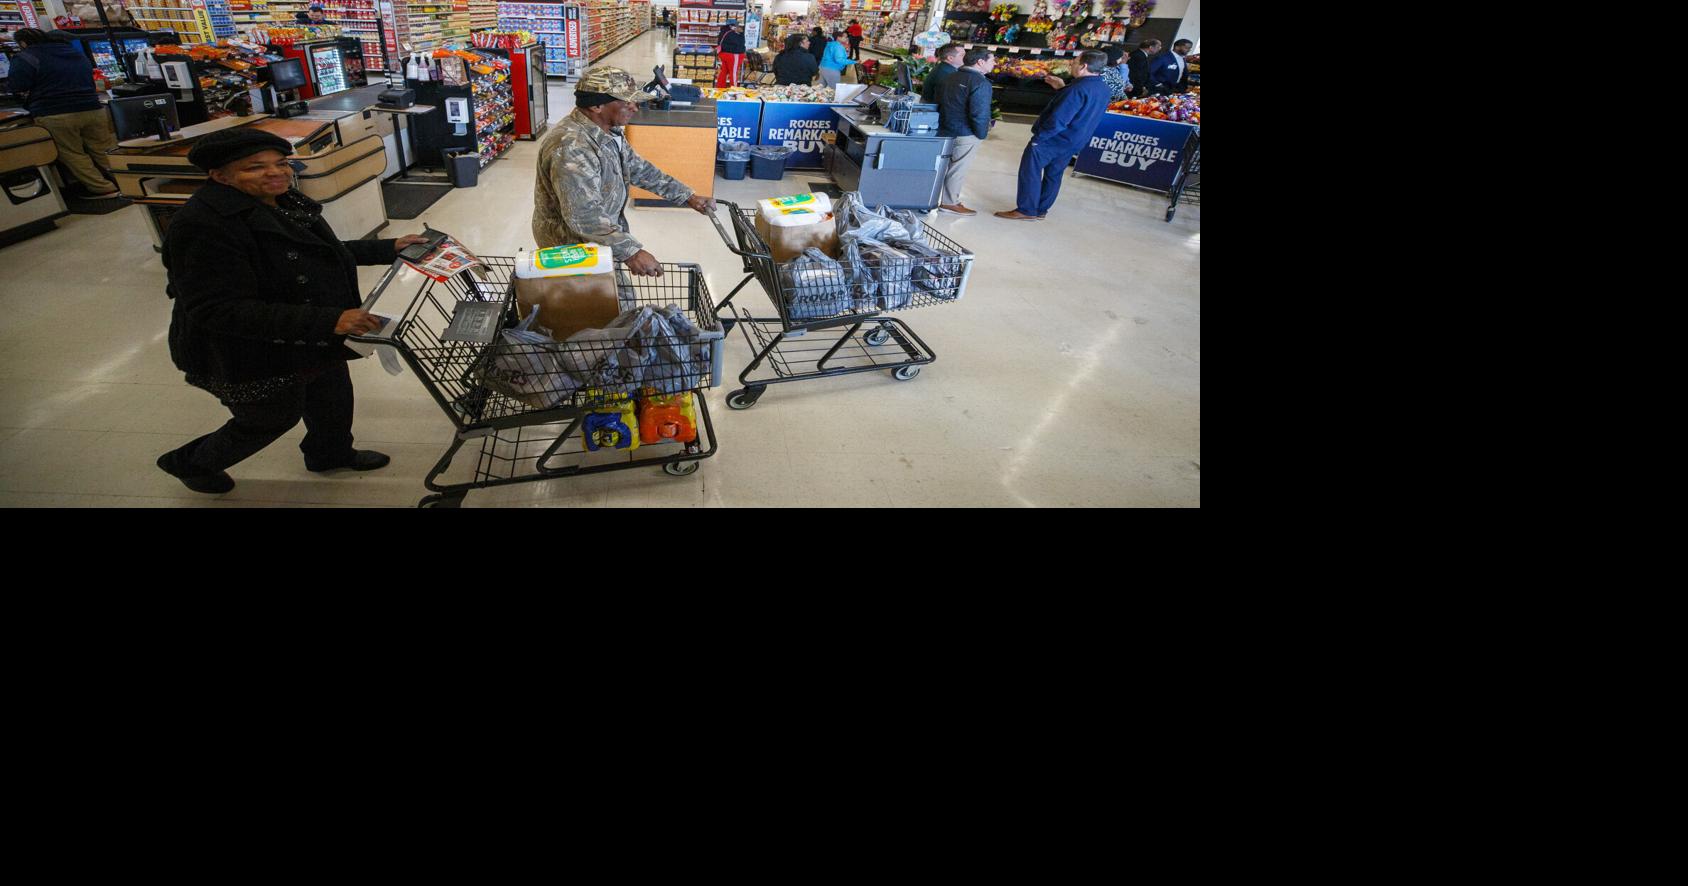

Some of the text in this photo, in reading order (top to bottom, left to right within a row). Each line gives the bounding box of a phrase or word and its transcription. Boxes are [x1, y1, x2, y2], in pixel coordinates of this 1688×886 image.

[568, 20, 577, 48] ADVERTISED
[789, 119, 832, 129] ROUSES
[782, 140, 825, 153] BUY
[1113, 130, 1160, 146] ROUSES
[1089, 136, 1178, 163] REMARKABLE
[1099, 150, 1157, 171] BUY
